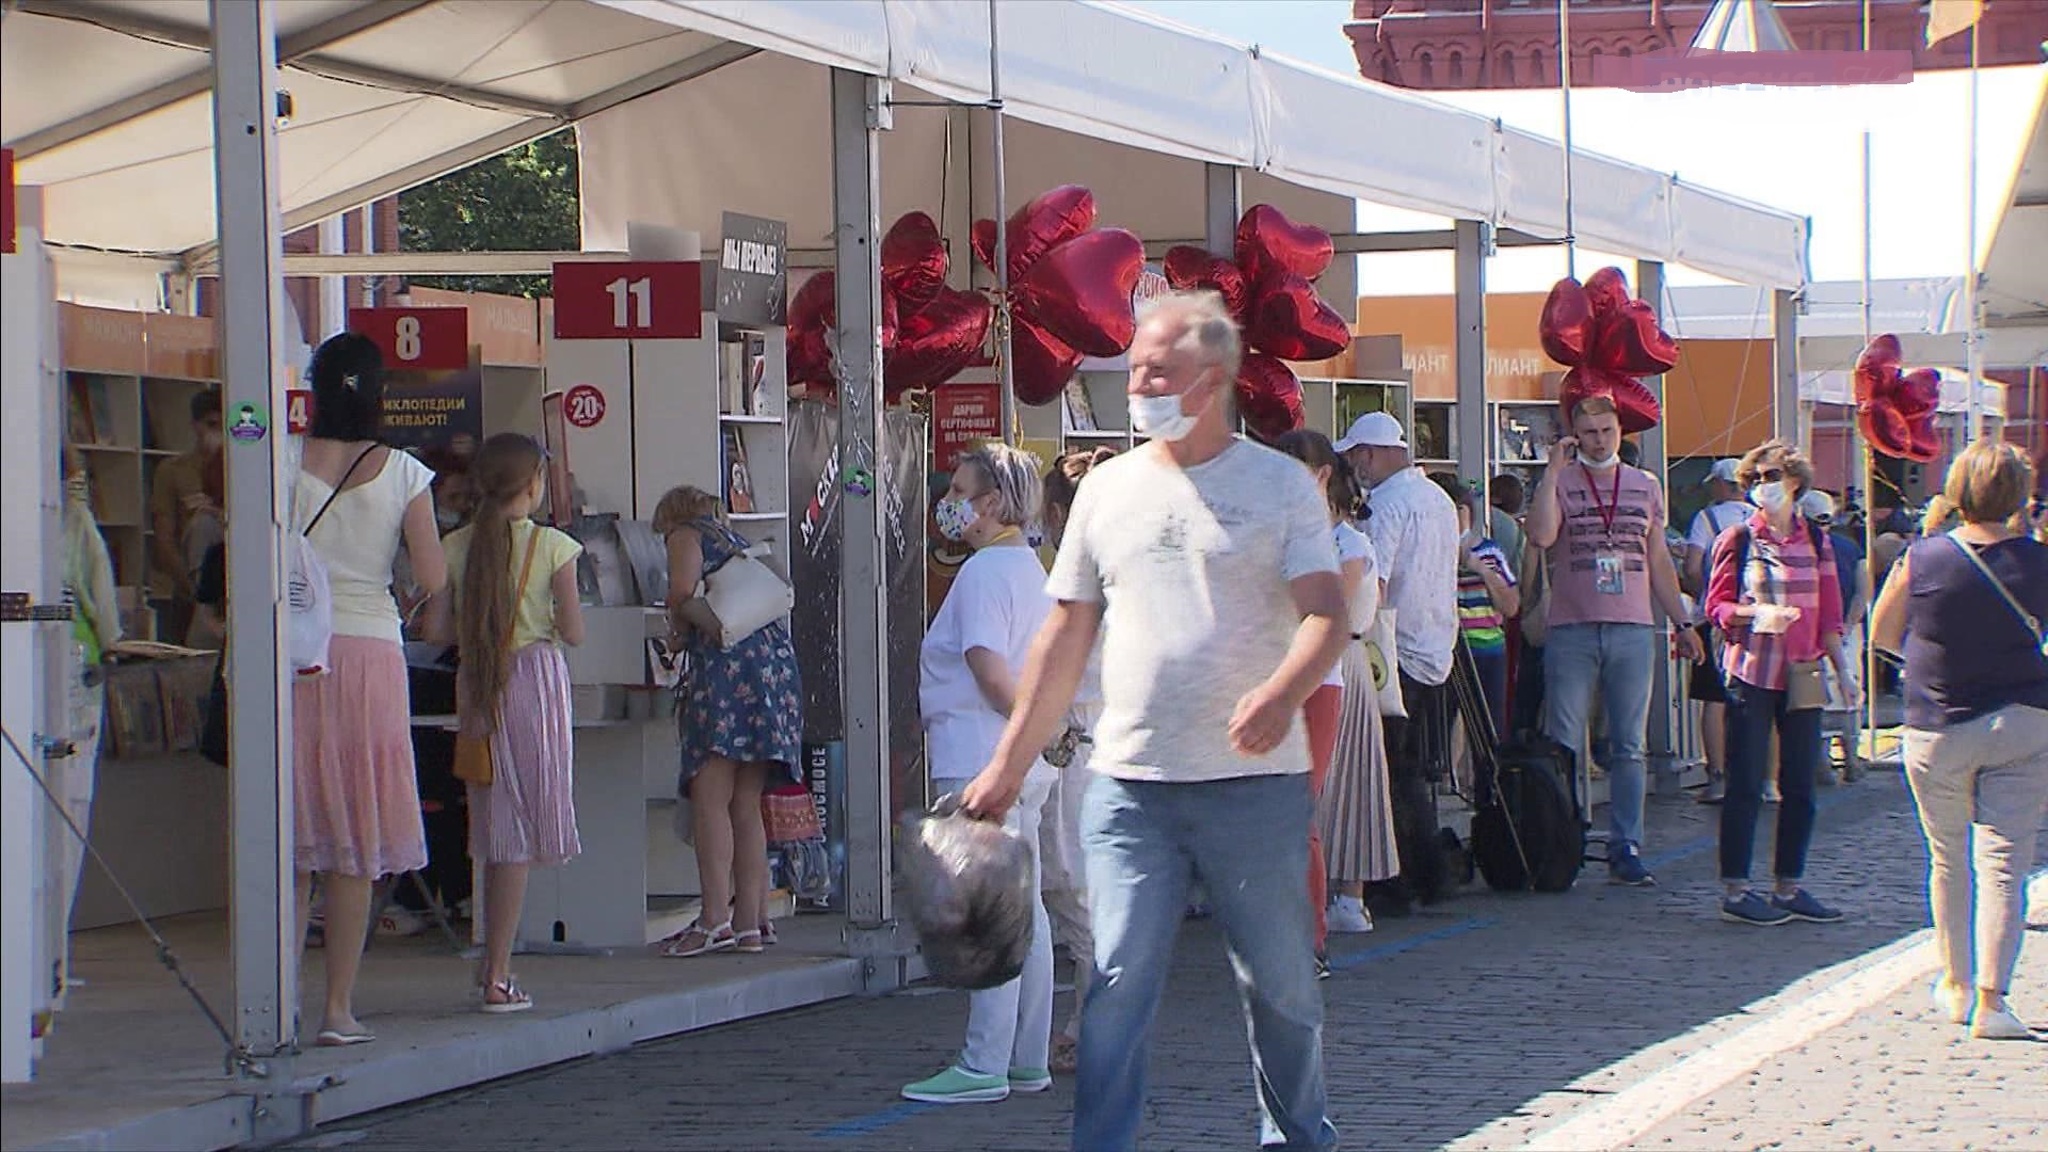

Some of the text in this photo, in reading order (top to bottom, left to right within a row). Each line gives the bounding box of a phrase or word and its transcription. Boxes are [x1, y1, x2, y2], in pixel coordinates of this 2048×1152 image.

[605, 277, 652, 329] 11
[395, 316, 421, 361] 8
[1402, 353, 1449, 374] ИАНТ
[1486, 356, 1540, 377] ЛИАНТ
[382, 397, 465, 411] ИКЛОПЕДИИ
[571, 395, 598, 420] 20
[383, 413, 448, 426] ЖИВАЮТ!
